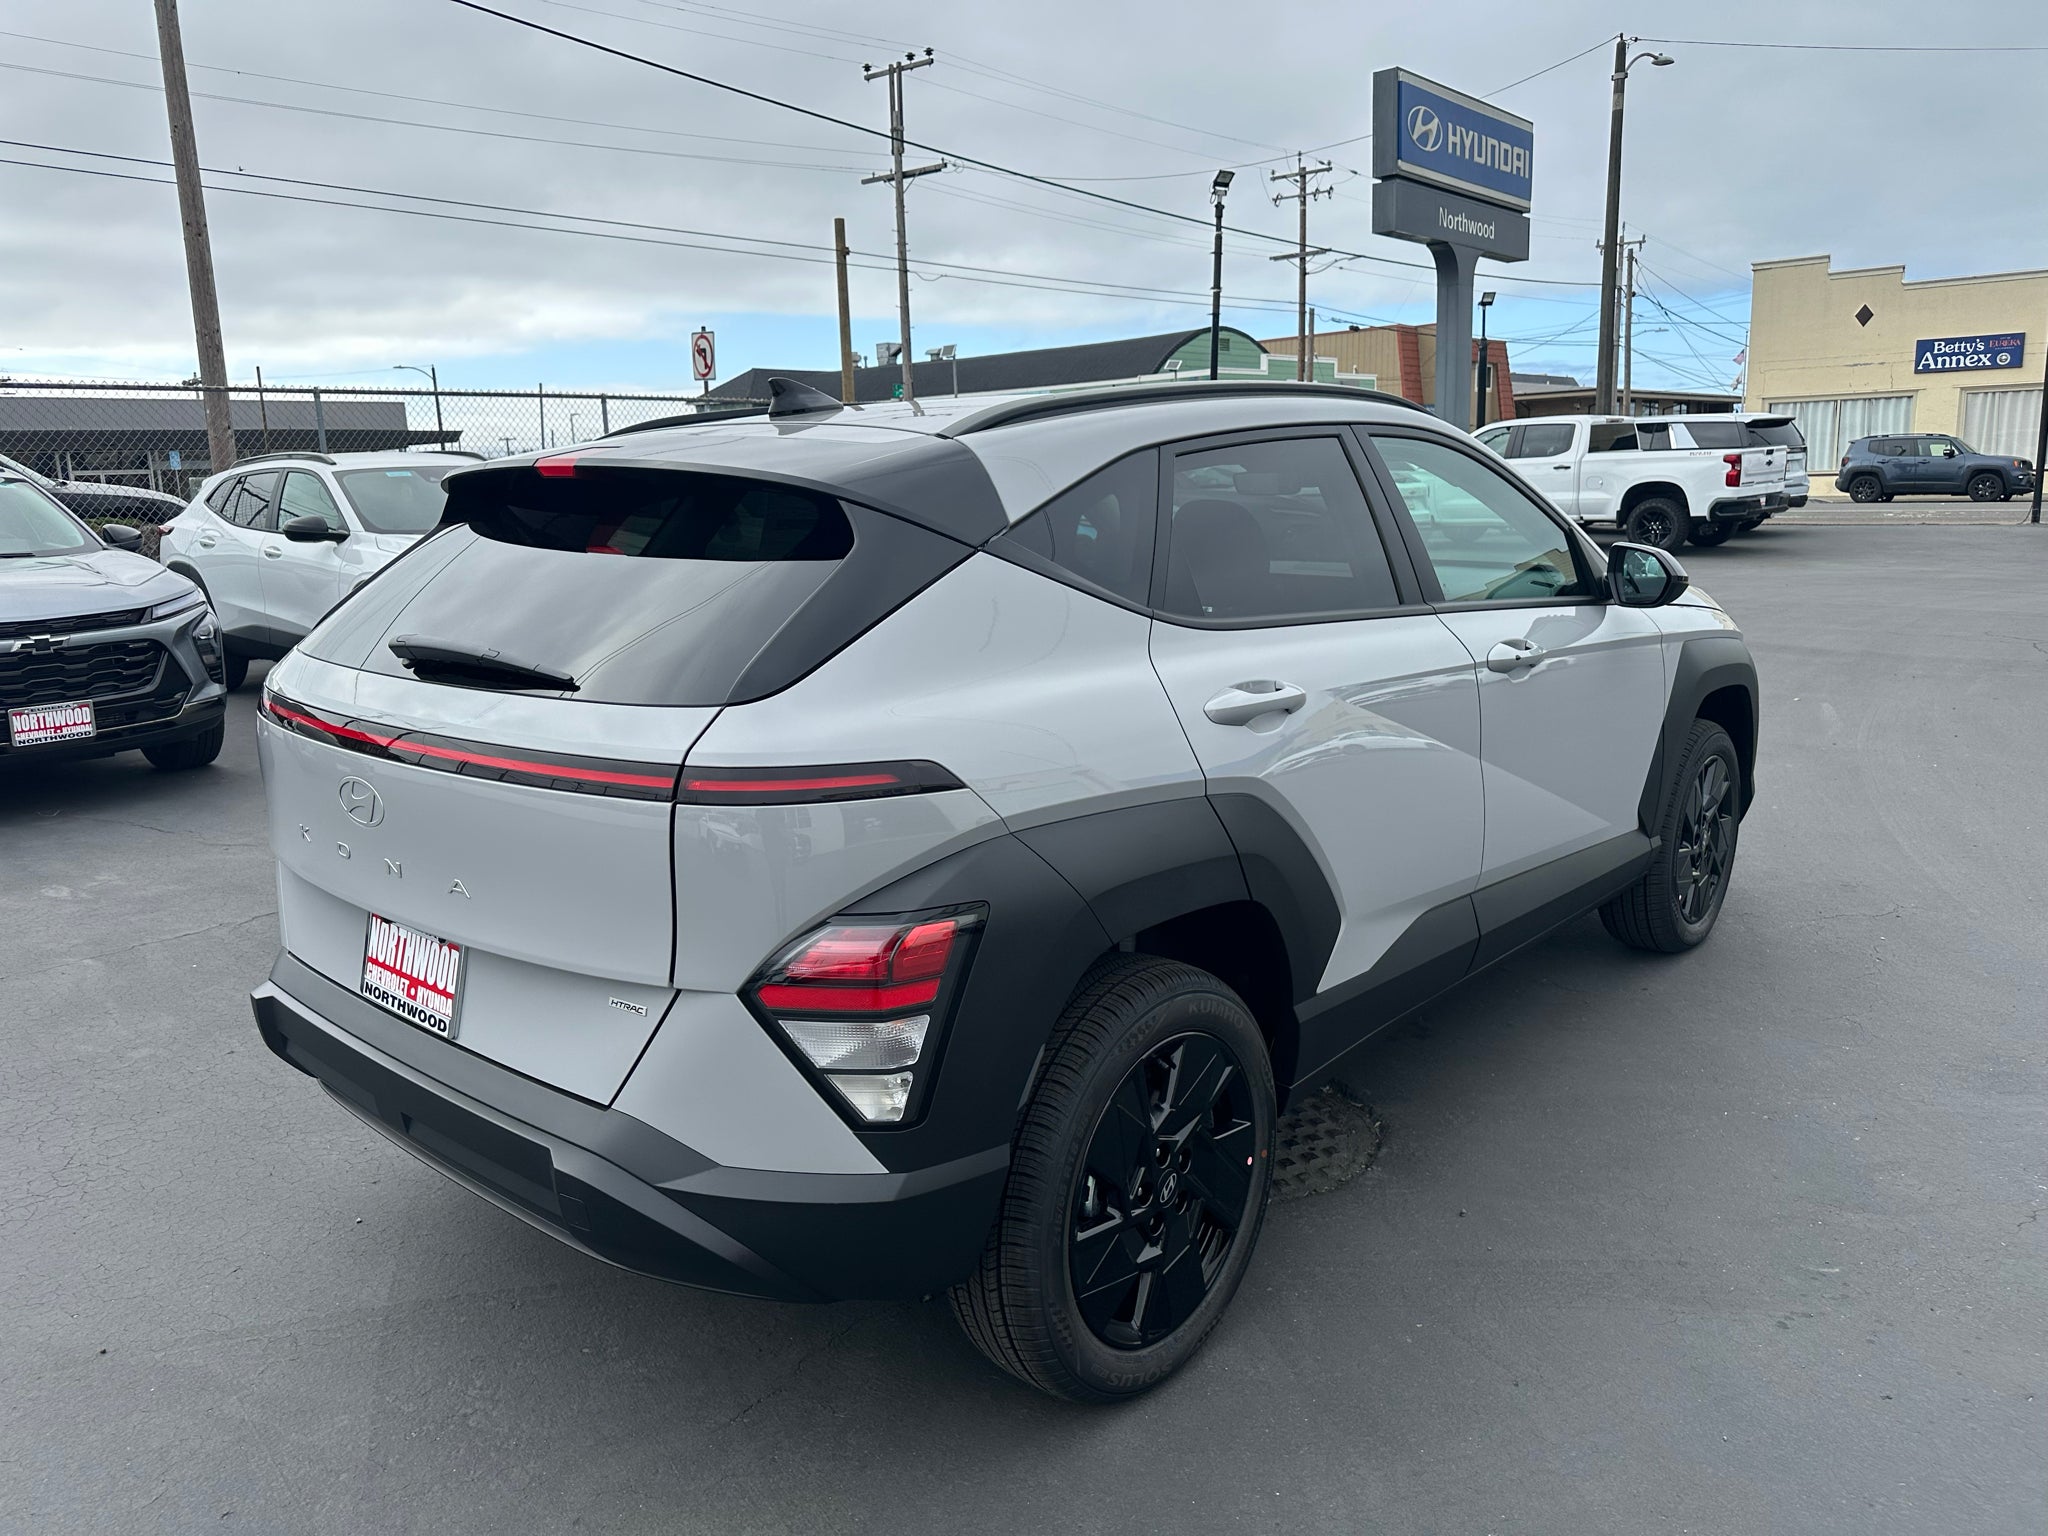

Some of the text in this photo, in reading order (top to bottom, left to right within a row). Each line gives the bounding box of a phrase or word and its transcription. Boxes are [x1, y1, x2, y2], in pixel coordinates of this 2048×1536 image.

[1448, 122, 1530, 179] HYUNDAI
[1439, 206, 1495, 240] Northwood
[1933, 338, 1985, 354] Betty's
[1917, 351, 1992, 370] Annex
[12, 706, 91, 732] NORTHWOOD
[30, 704, 72, 713] EUREKA
[15, 723, 93, 740] CHEVROLET HYUNDAI
[18, 730, 92, 746] NORTHWOOD
[299, 823, 471, 899] KONA
[368, 916, 460, 994] NORTHWOOD
[366, 962, 453, 1018] CHEVROLET HYUNDA
[365, 982, 447, 1033] NORTHWOOD
[610, 999, 644, 1015] HTRAC
[1188, 999, 1244, 1029] KUMHO
[1107, 1360, 1174, 1387] SOLUS
